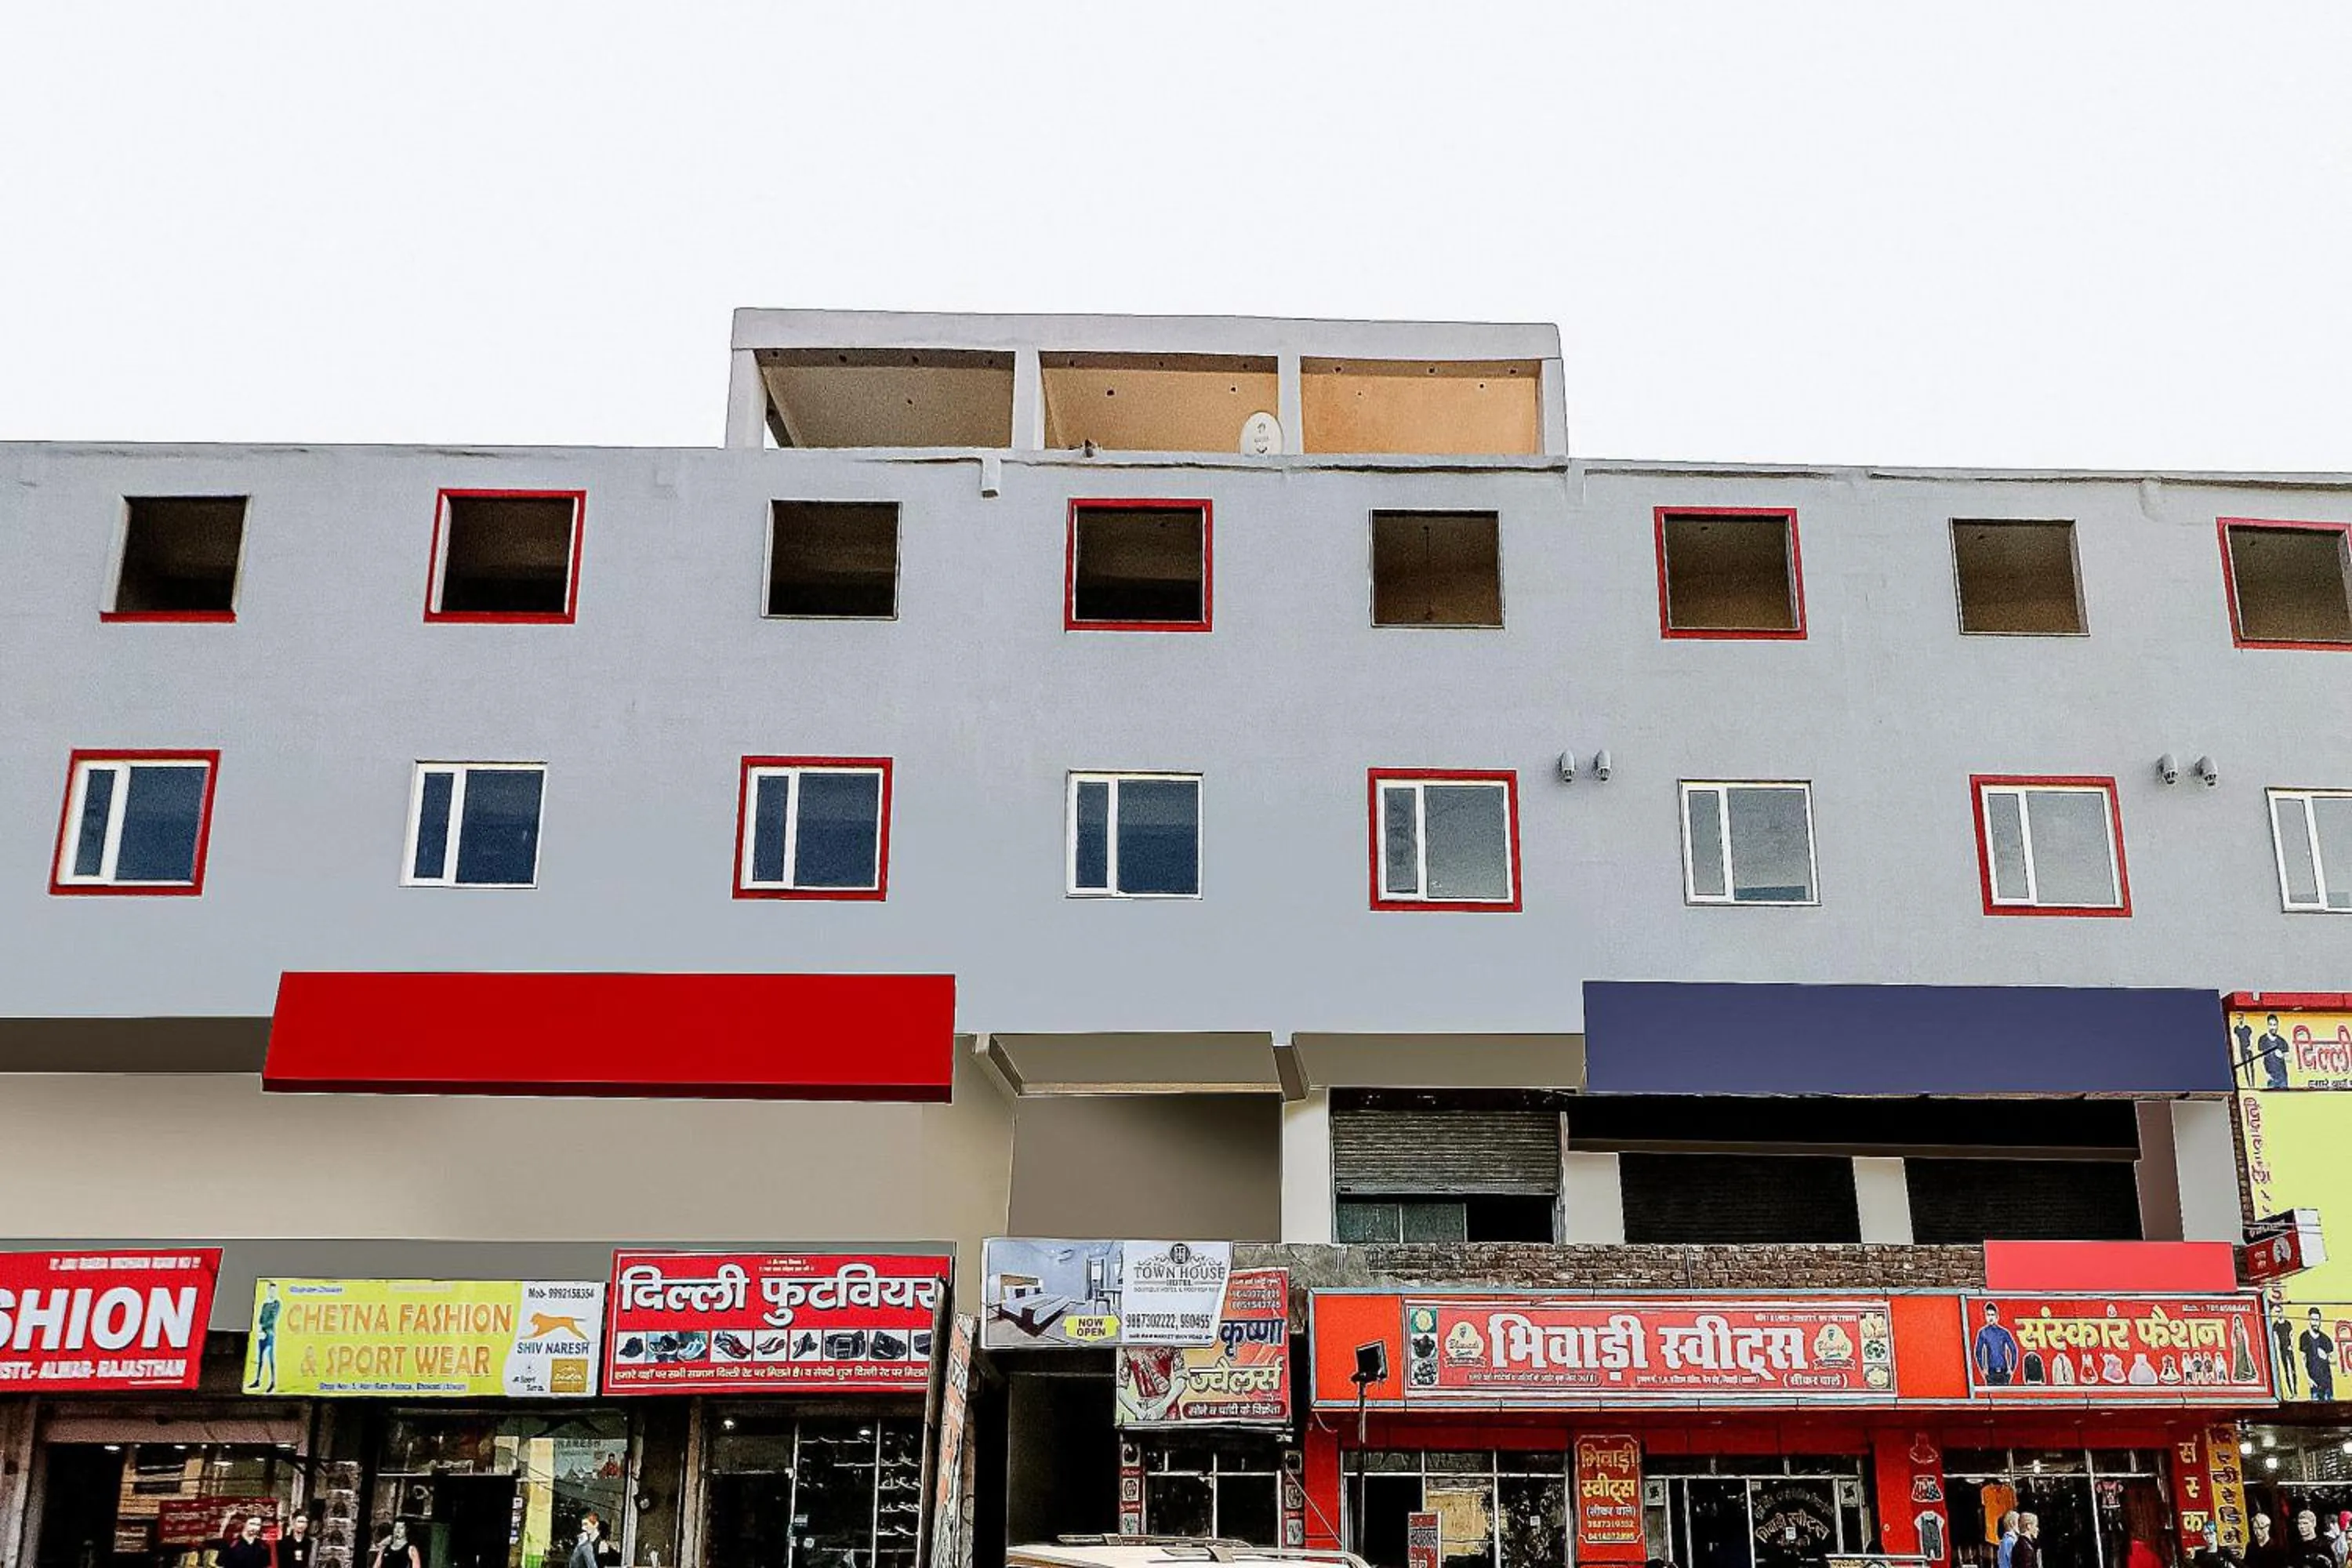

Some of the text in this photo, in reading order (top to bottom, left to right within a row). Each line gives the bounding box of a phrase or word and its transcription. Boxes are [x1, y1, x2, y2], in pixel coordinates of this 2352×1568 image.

[1134, 1266, 1225, 1279] TOWN HOUSE
[620, 1264, 943, 1326] दिल्ली फुटवियर
[286, 1304, 513, 1333] CHETNA FASHION
[2135, 1305, 2227, 1349] फैशन
[517, 1341, 590, 1355] SHIV NARESH
[1220, 1319, 1286, 1359] कृष्णा
[1488, 1313, 1809, 1381] भिवाड़ी स्वीट्स
[300, 1345, 492, 1377] & SPORT WEAR
[754, 1369, 766, 1377] पर
